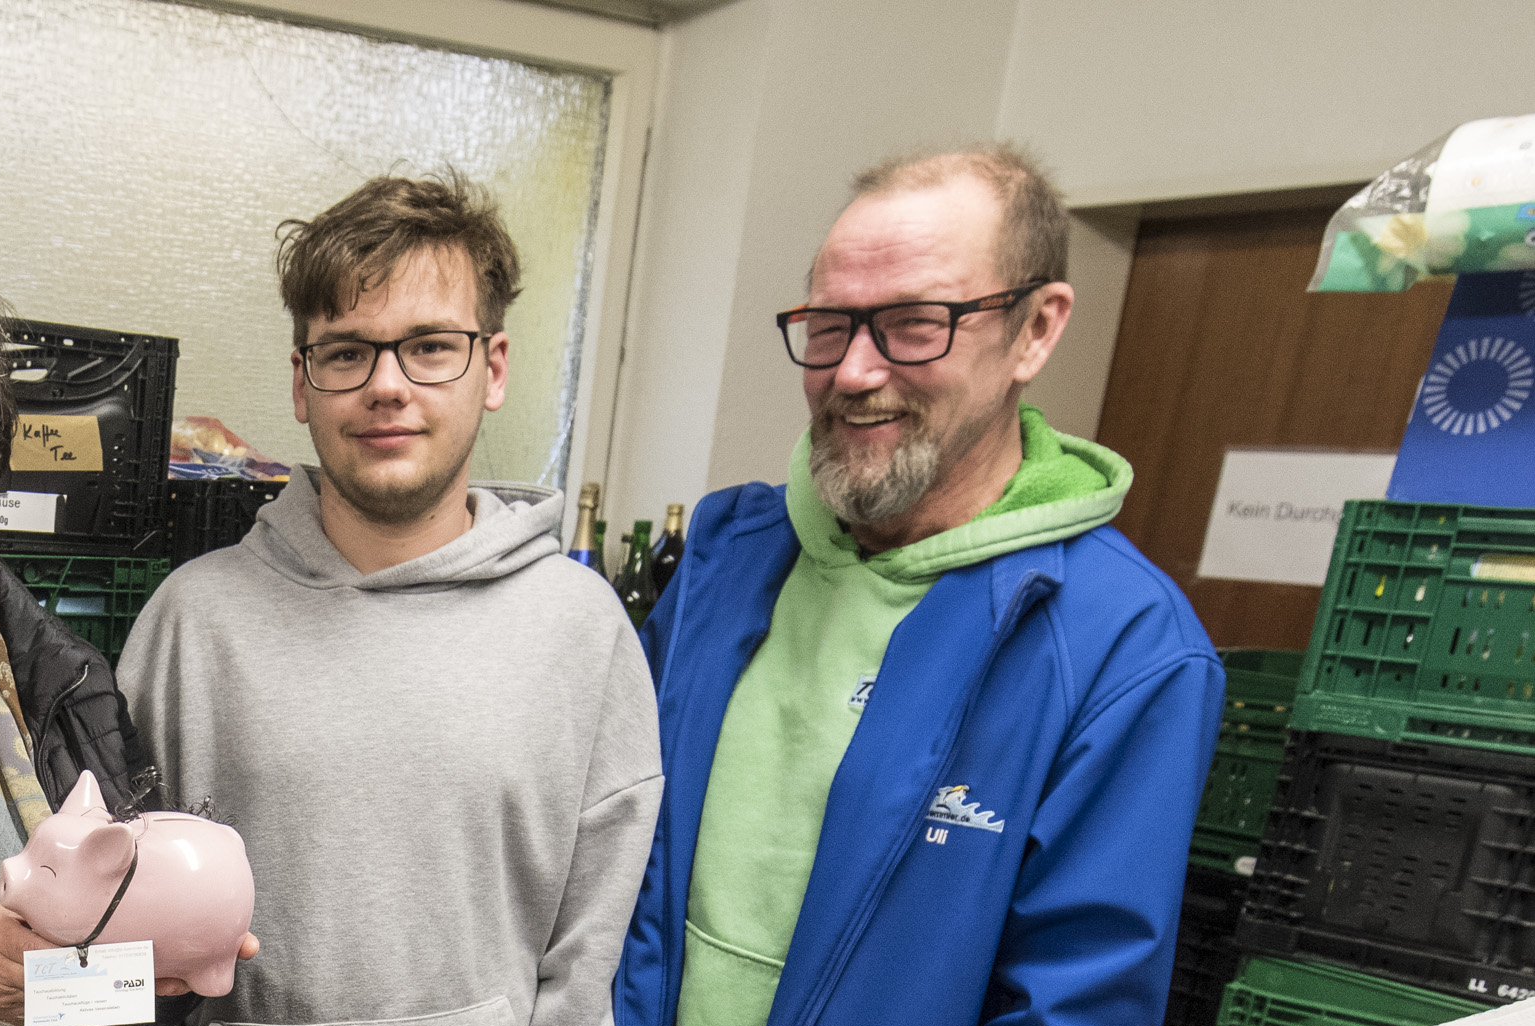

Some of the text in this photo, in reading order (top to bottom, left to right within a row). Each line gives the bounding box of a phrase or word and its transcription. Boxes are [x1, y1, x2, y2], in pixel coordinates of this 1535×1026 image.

[24, 423, 62, 447] Kaffee
[50, 445, 77, 461] Tee
[1228, 502, 1270, 518] Kein
[926, 826, 949, 845] Uli
[123, 979, 145, 988] PADI
[1468, 977, 1488, 993] LL
